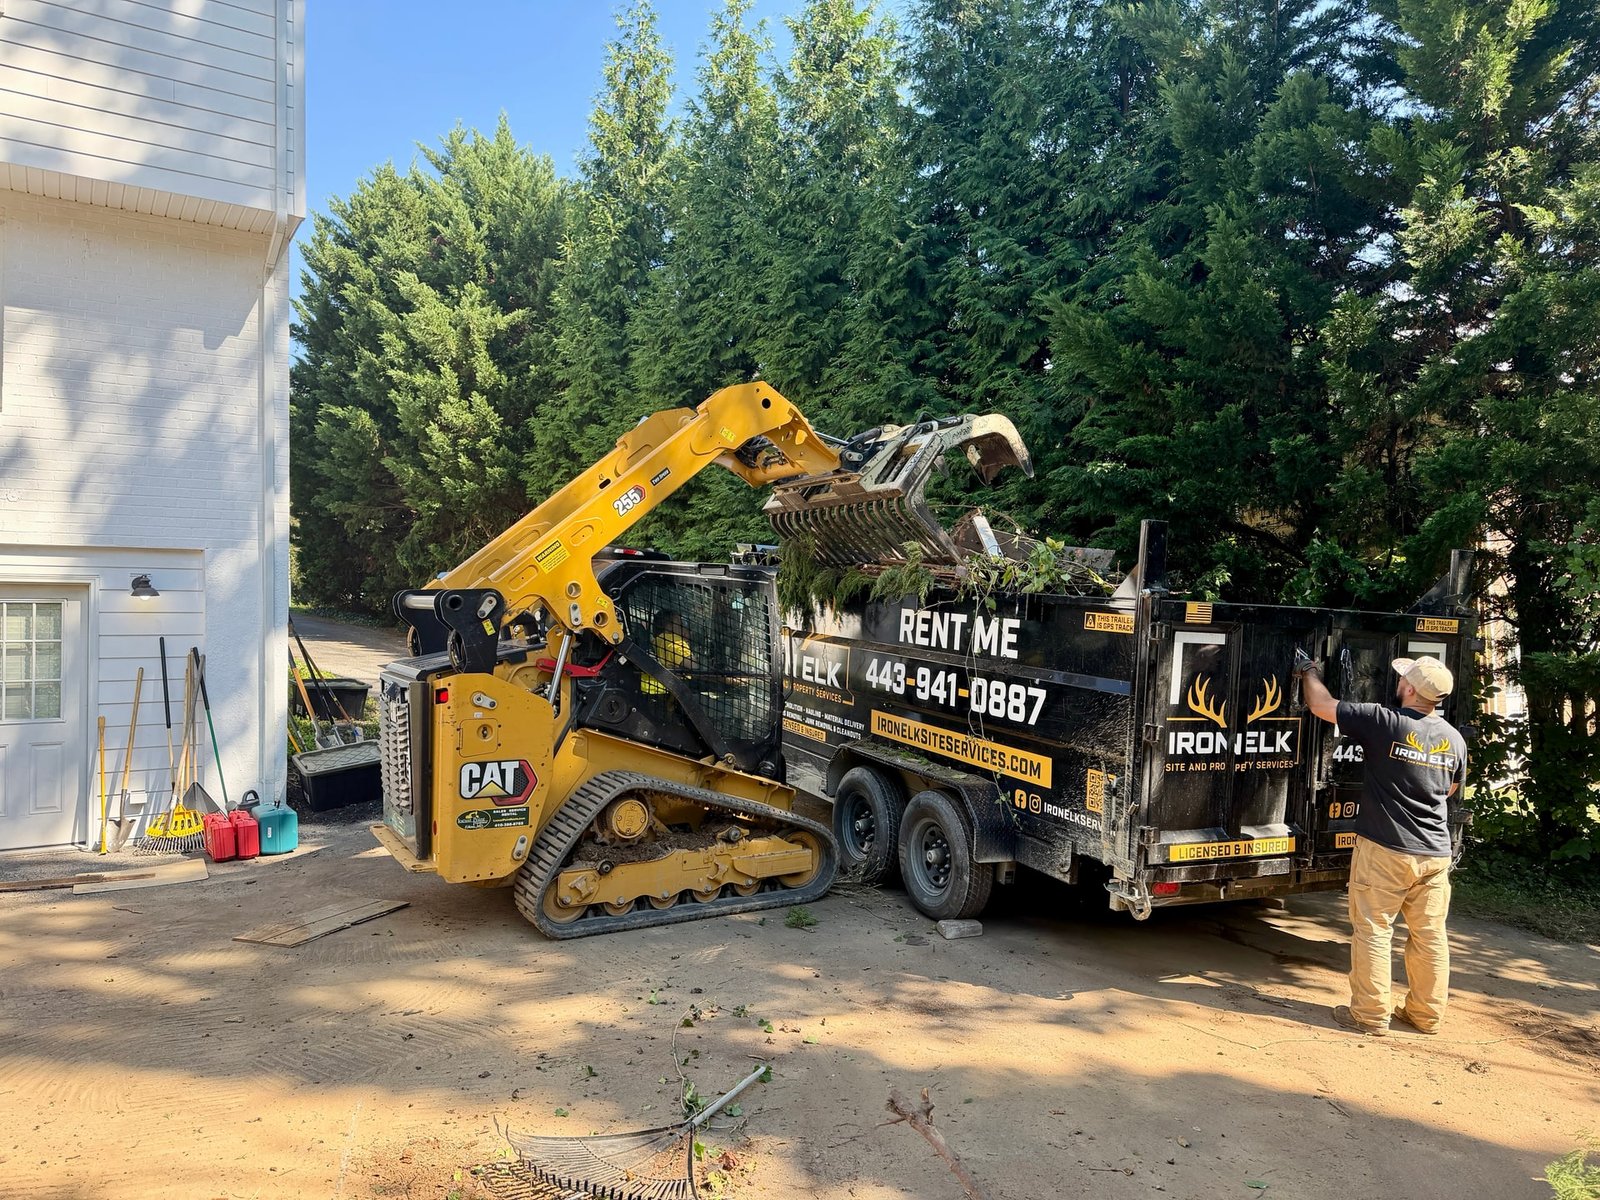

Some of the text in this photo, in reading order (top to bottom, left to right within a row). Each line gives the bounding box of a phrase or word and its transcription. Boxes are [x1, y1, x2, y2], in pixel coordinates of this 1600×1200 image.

[613, 489, 640, 516] 255
[899, 608, 1020, 659] RENT ME
[802, 655, 842, 690] ELK
[793, 682, 815, 695] ROPERTY
[815, 689, 842, 703] SERVICES
[866, 658, 1047, 726] 443-941-0887
[844, 719, 865, 730] DELIVERY
[877, 716, 1041, 779] IRONELKSITESERVICES.COM
[1168, 731, 1293, 755] IRON ELK
[1165, 760, 1294, 772] SITE AND PROPETY SERVICES
[1395, 747, 1427, 761] IRON
[1430, 755, 1454, 767] ELK
[461, 761, 519, 798] CAT
[1179, 841, 1288, 859] LICENSED & INSURED
